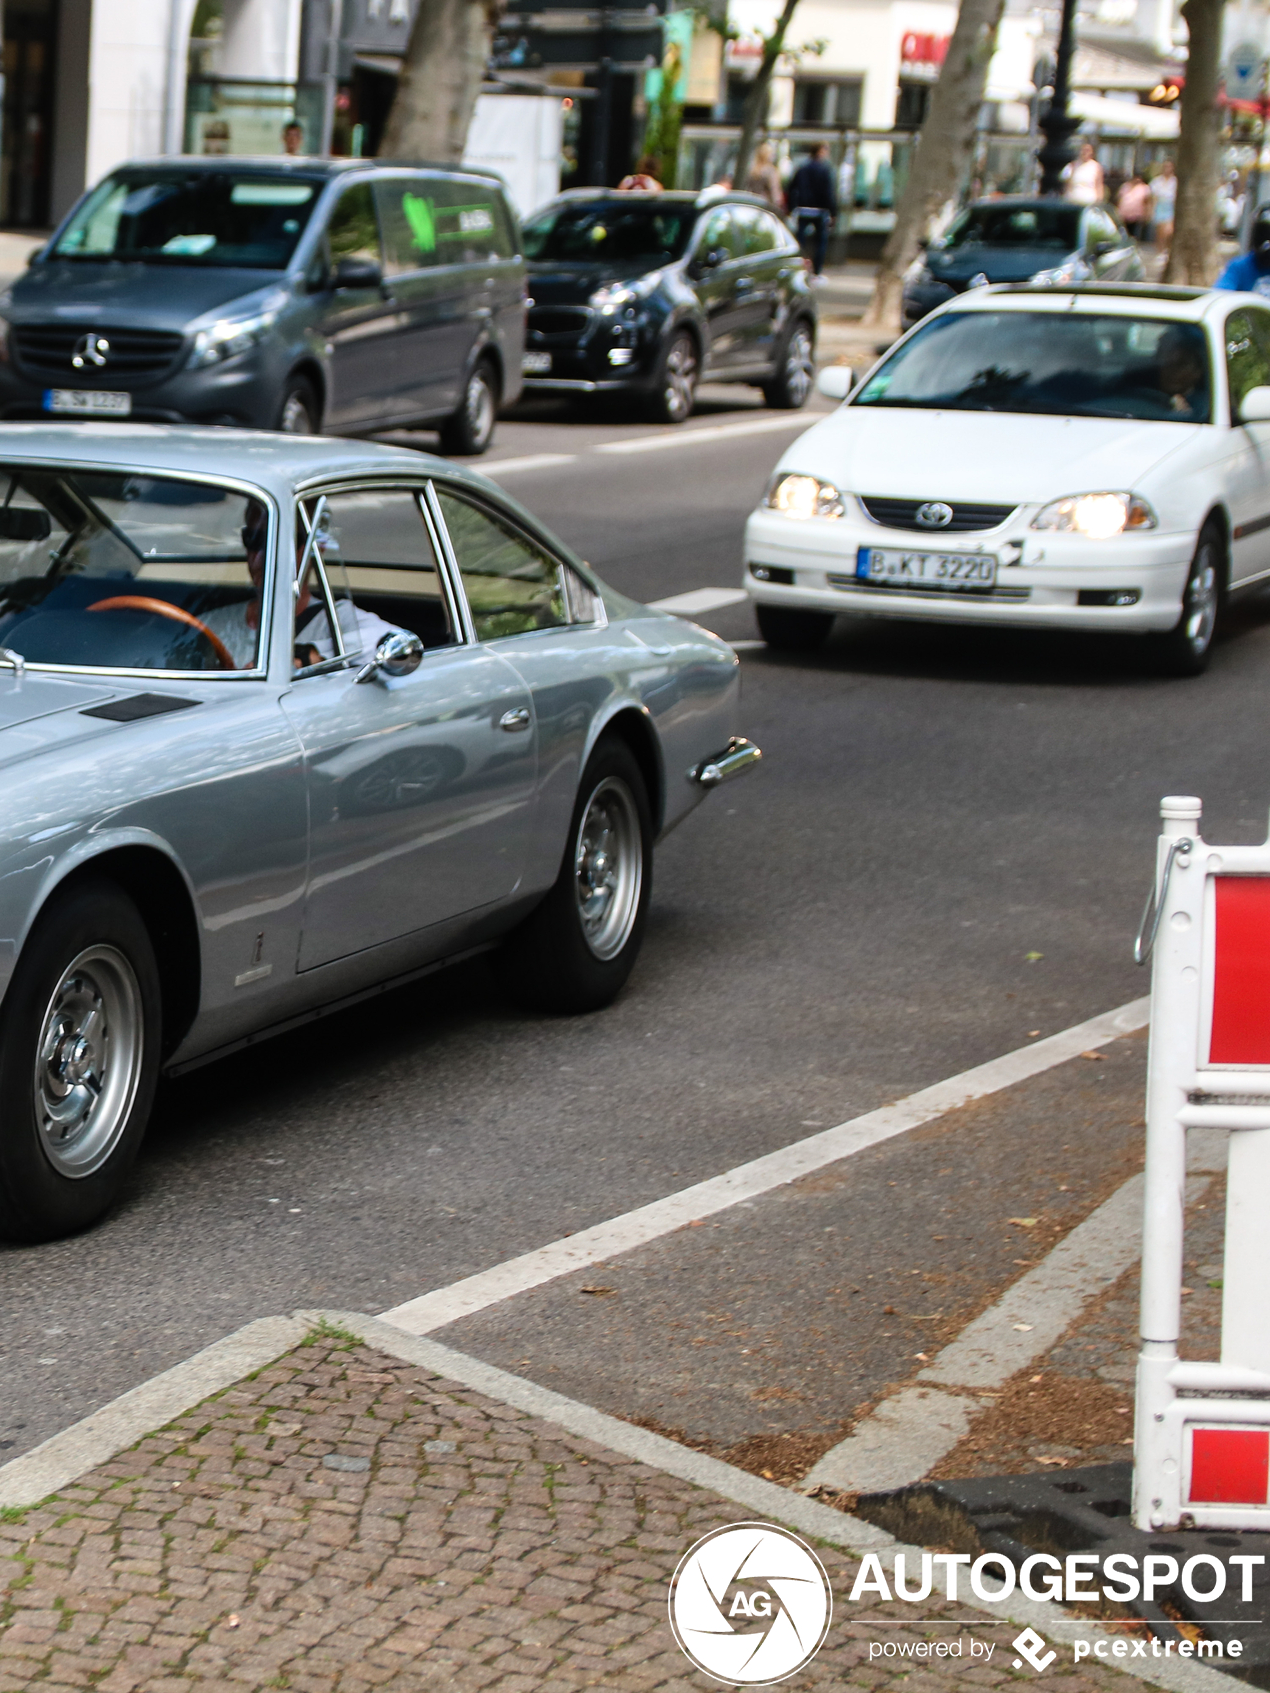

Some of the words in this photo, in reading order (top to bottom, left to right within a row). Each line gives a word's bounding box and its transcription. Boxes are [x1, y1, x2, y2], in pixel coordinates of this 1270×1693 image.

[871, 551, 885, 574] B
[900, 552, 930, 576] KT
[936, 554, 993, 581] 3220
